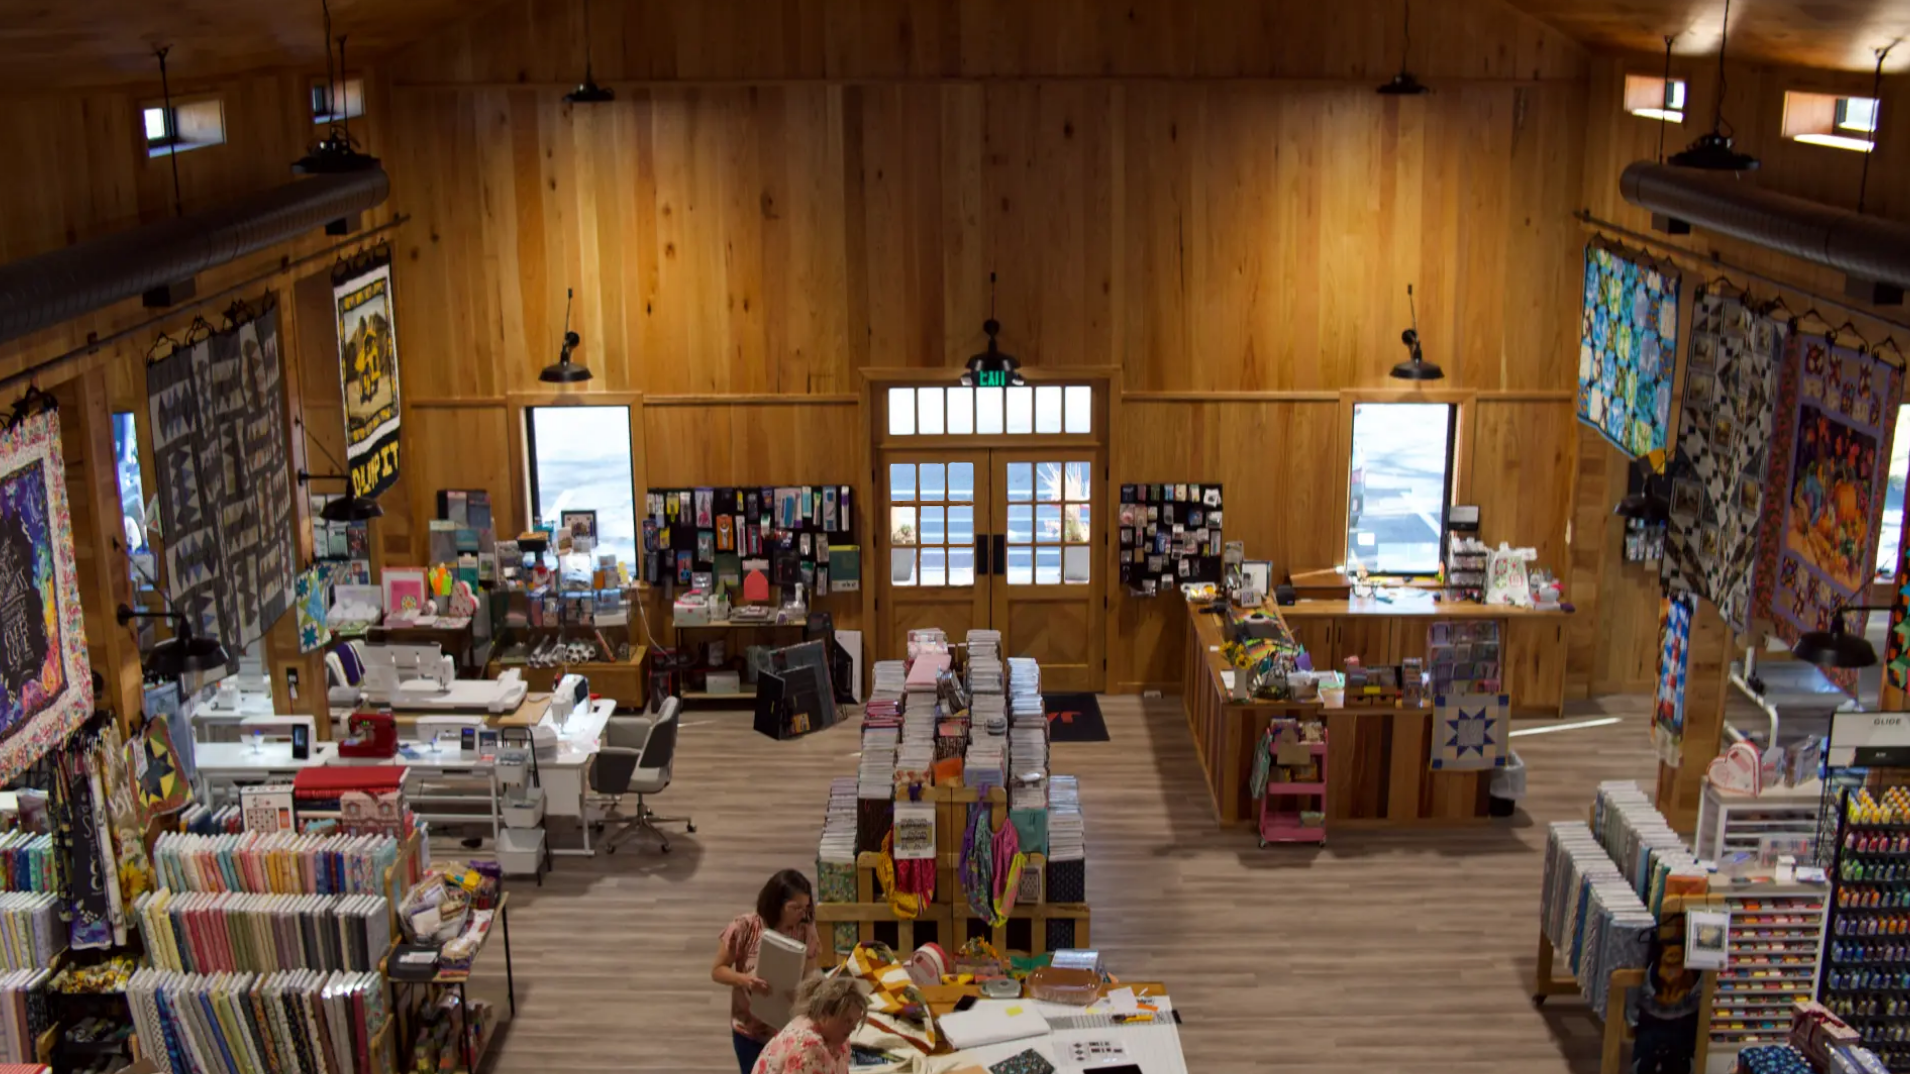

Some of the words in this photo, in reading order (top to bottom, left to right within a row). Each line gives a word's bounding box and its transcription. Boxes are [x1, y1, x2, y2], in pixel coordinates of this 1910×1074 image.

[979, 370, 1005, 386] EXIT
[380, 440, 399, 478] IT
[1873, 717, 1902, 726] GLIDE
